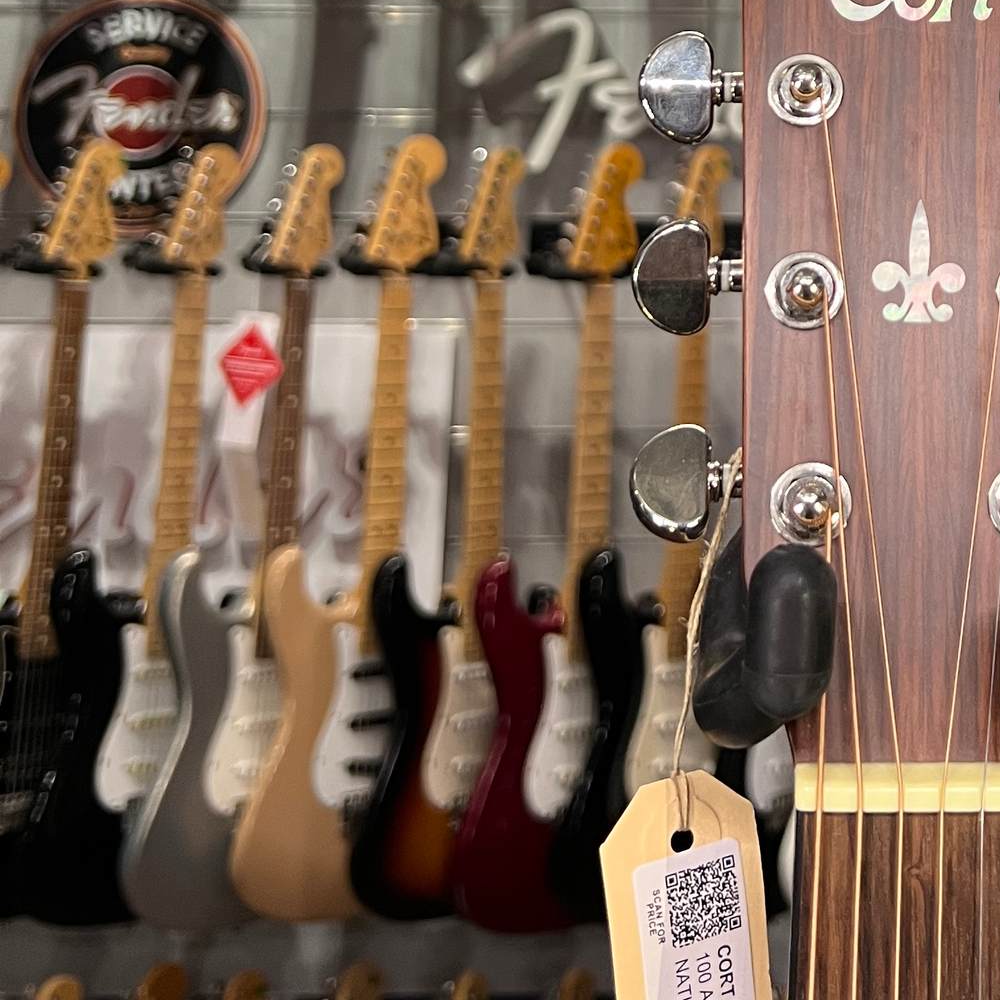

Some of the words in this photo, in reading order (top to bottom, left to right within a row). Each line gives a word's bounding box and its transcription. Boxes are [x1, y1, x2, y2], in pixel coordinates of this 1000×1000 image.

[86, 8, 208, 48] SERVICE
[646, 903, 657, 936] PRICE
[653, 889, 663, 919] SCAN
[657, 922, 666, 945] FOR
[696, 953, 712, 983] 100
[718, 945, 735, 996] CORT
